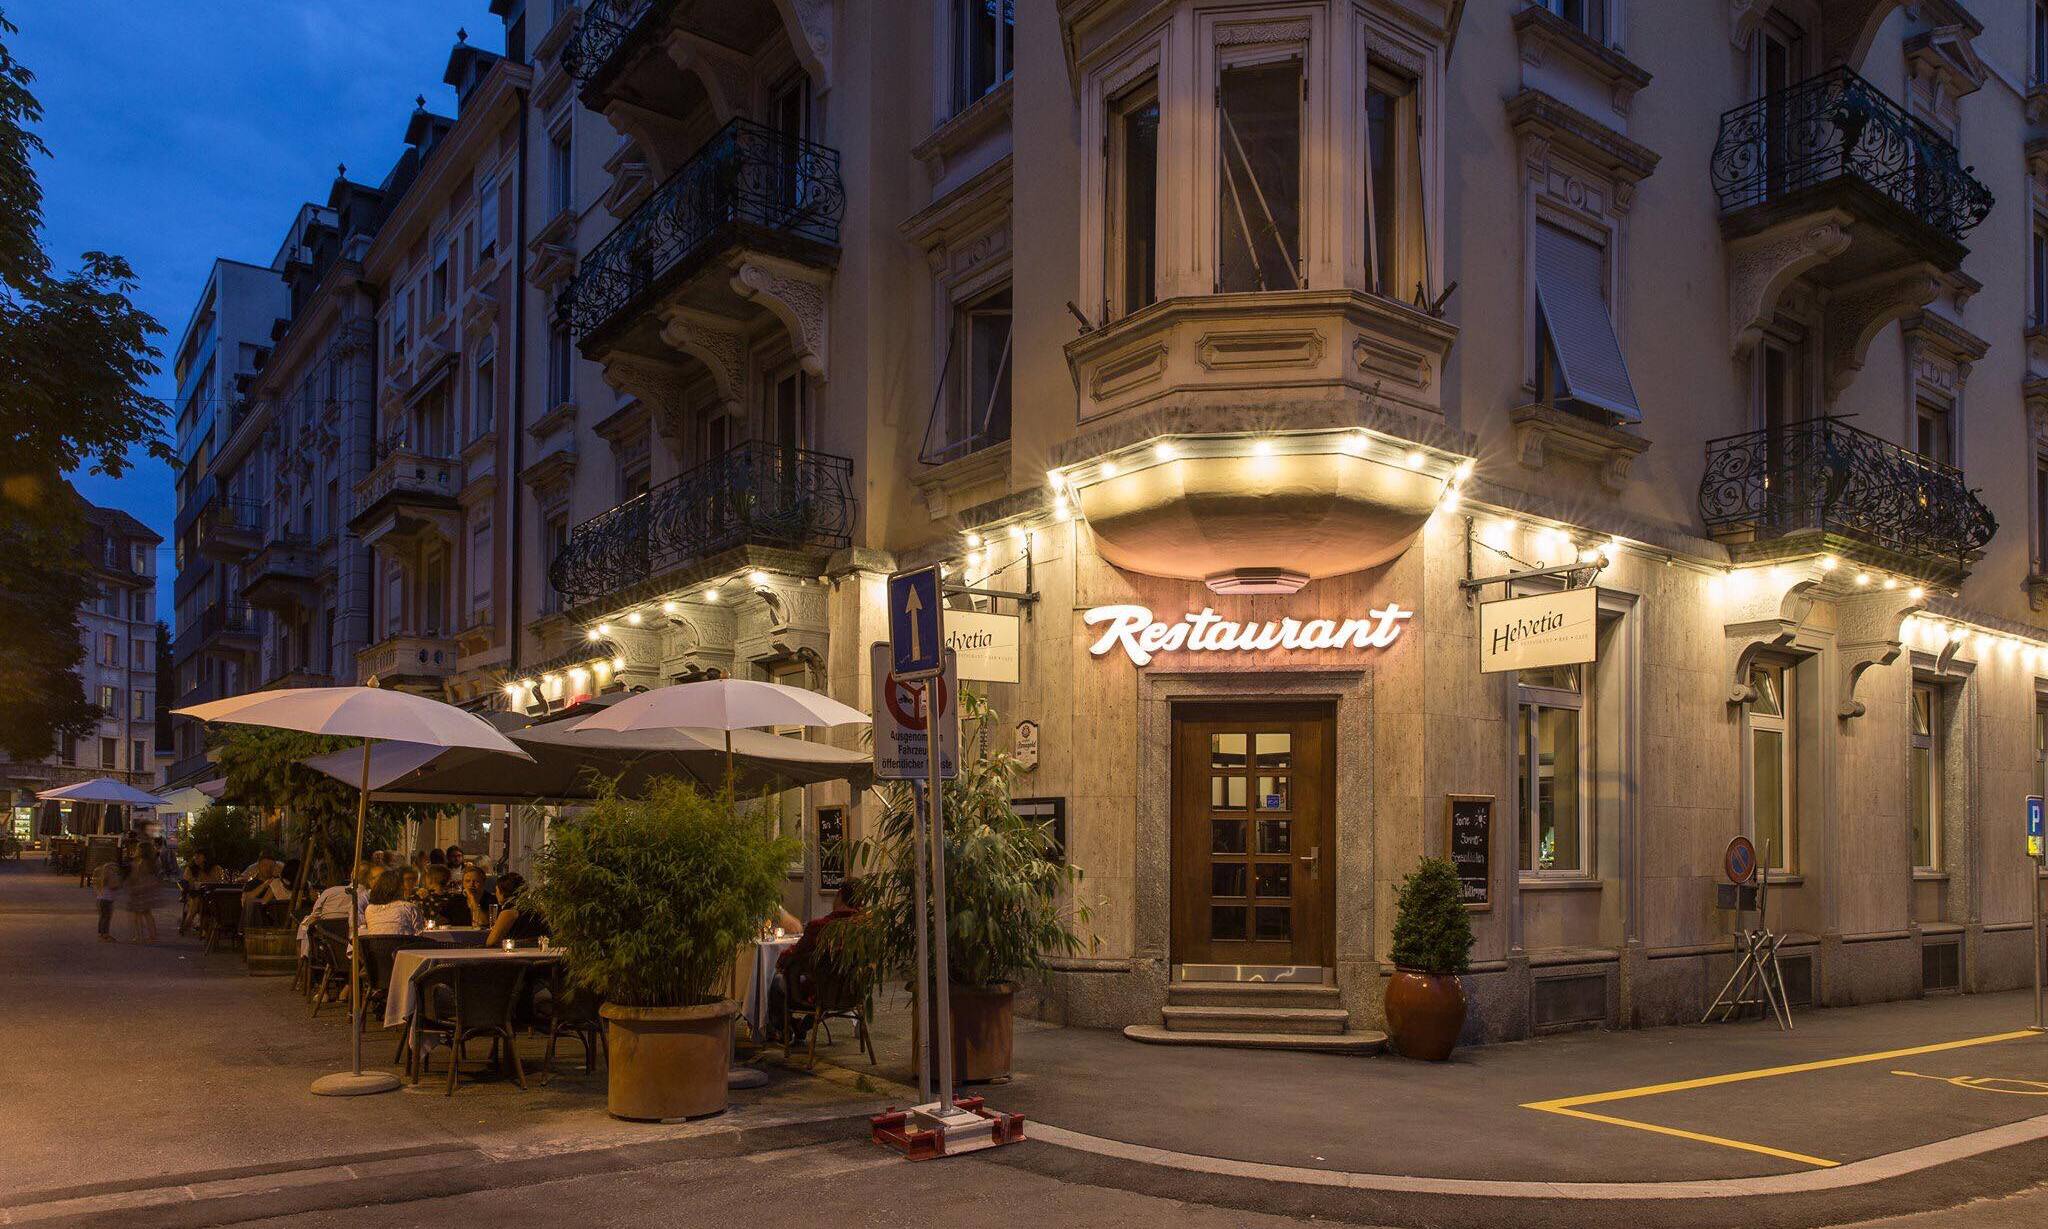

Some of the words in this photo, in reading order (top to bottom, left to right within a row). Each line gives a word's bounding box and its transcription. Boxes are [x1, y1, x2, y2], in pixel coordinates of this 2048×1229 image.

[945, 629, 992, 650] elvetia
[1083, 603, 1413, 667] Restaurant
[1492, 611, 1563, 655] Helvetia
[890, 730, 944, 744] Ausgenomn
[898, 745, 928, 755] Fahrzeu
[2032, 805, 2040, 833] P
